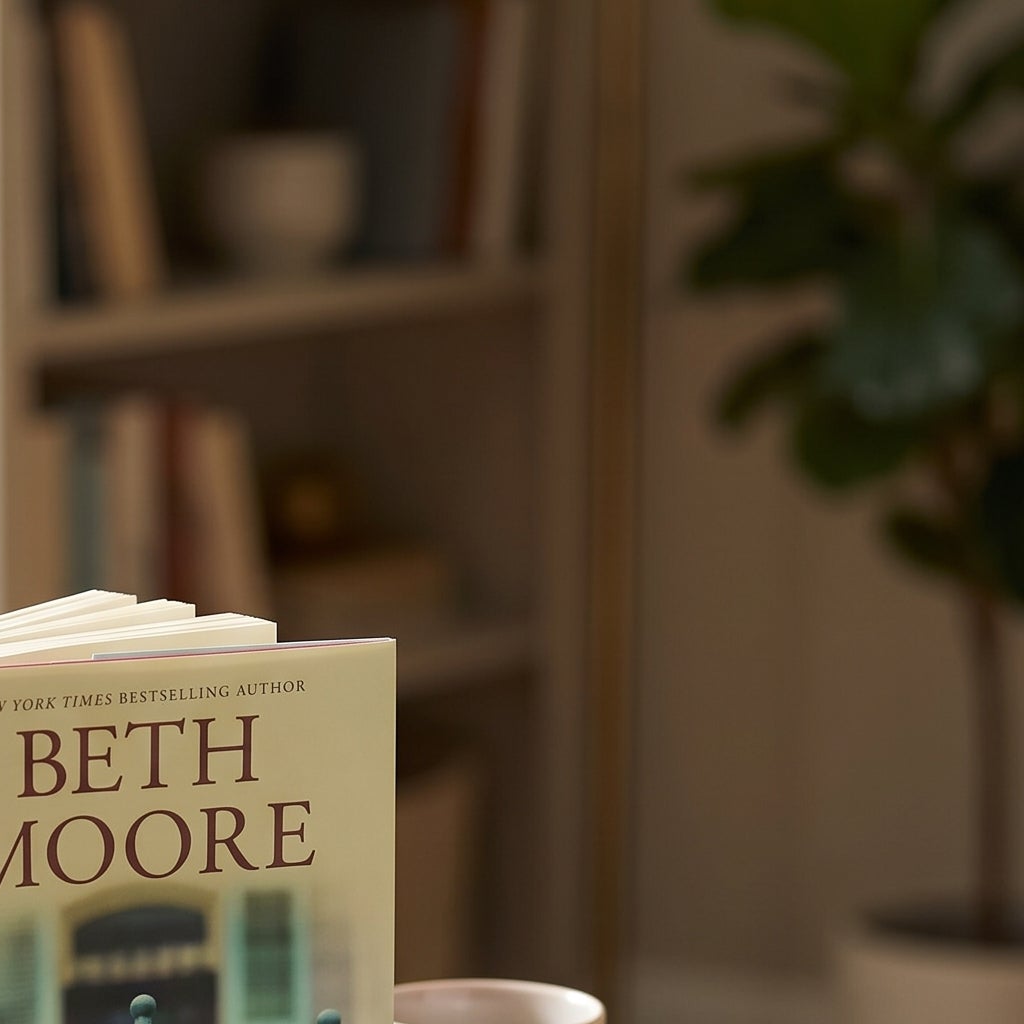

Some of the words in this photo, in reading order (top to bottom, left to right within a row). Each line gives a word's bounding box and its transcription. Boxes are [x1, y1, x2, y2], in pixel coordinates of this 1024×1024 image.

[13, 697, 57, 712] YORK
[62, 693, 113, 708] TIMES
[119, 685, 230, 705] BESTSELLING
[236, 679, 306, 697] AUTHOR
[16, 715, 260, 798] BETH
